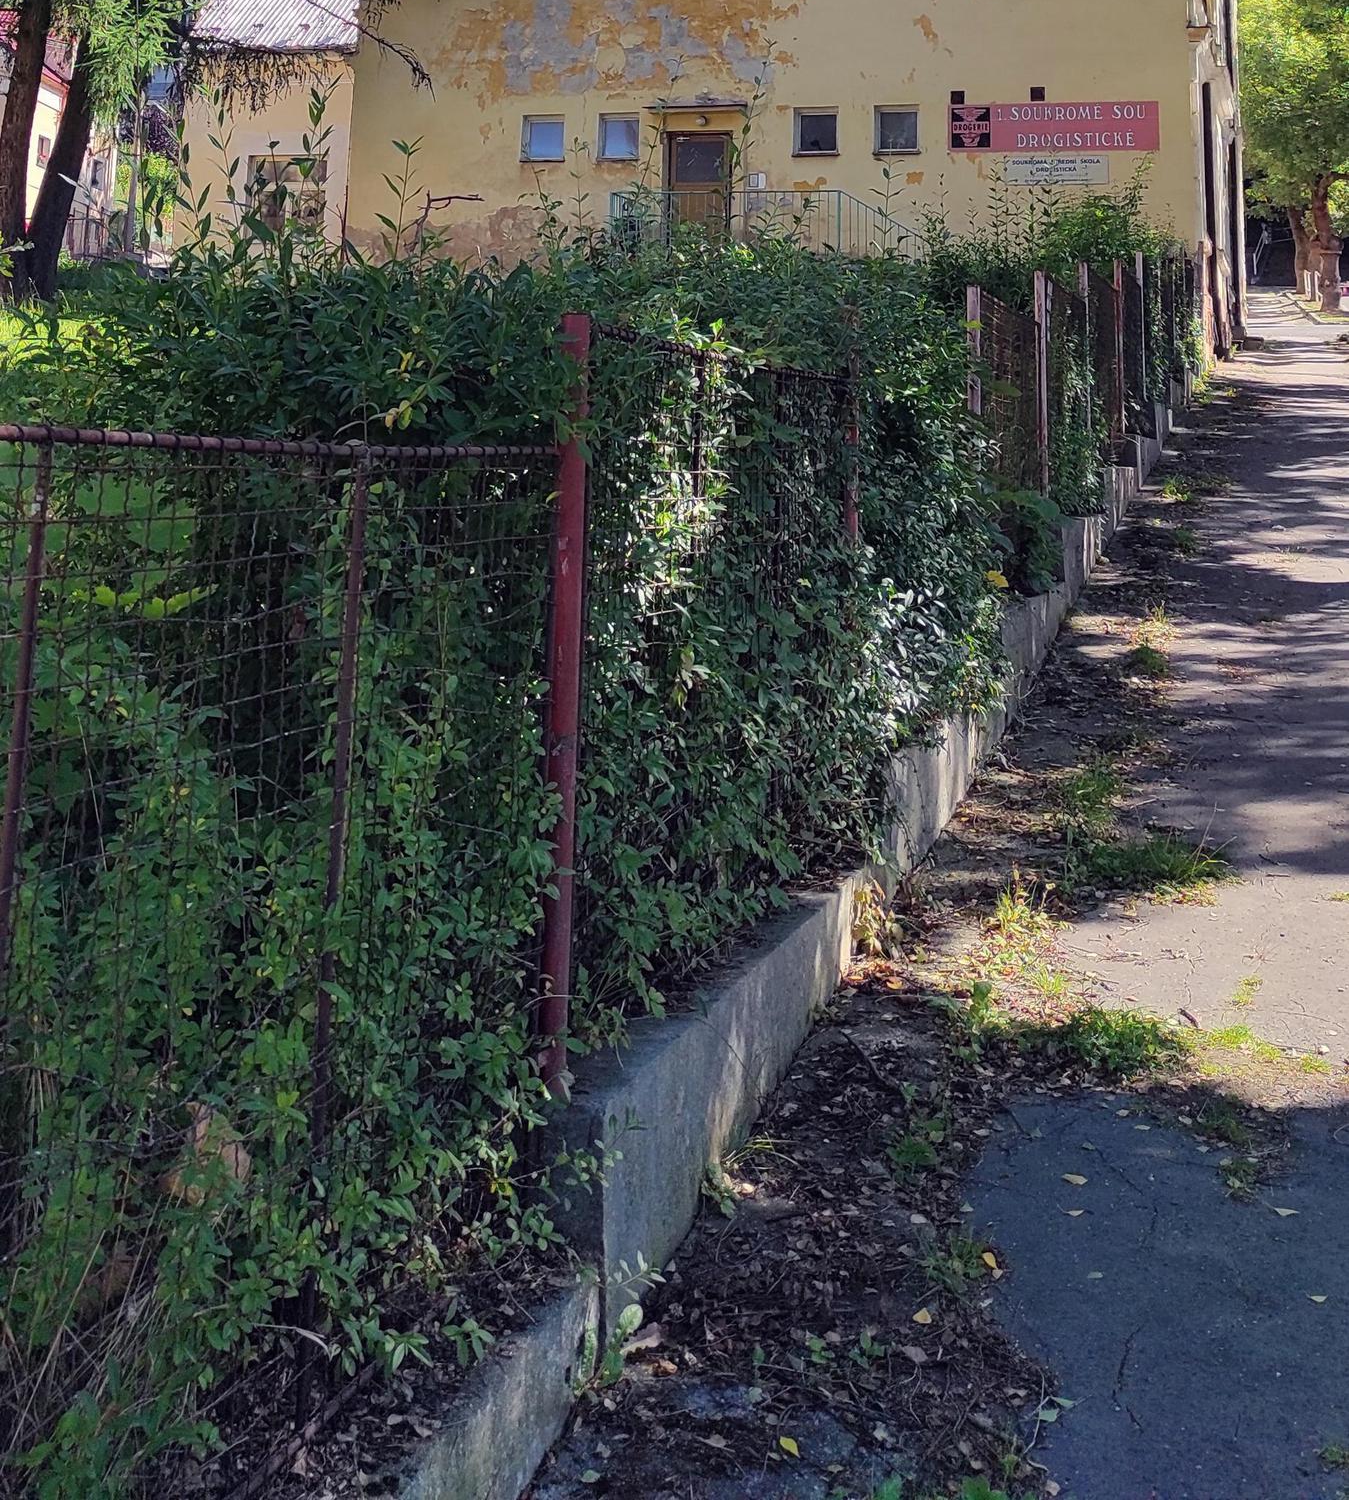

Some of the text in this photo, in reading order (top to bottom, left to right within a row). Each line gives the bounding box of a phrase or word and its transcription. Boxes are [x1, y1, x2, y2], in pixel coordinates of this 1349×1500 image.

[1010, 104, 1103, 121] SOUKROMÉ
[1111, 104, 1146, 120] SOU
[953, 123, 989, 132] DROGERIE
[1016, 131, 1136, 148] DROGISTICKÉ
